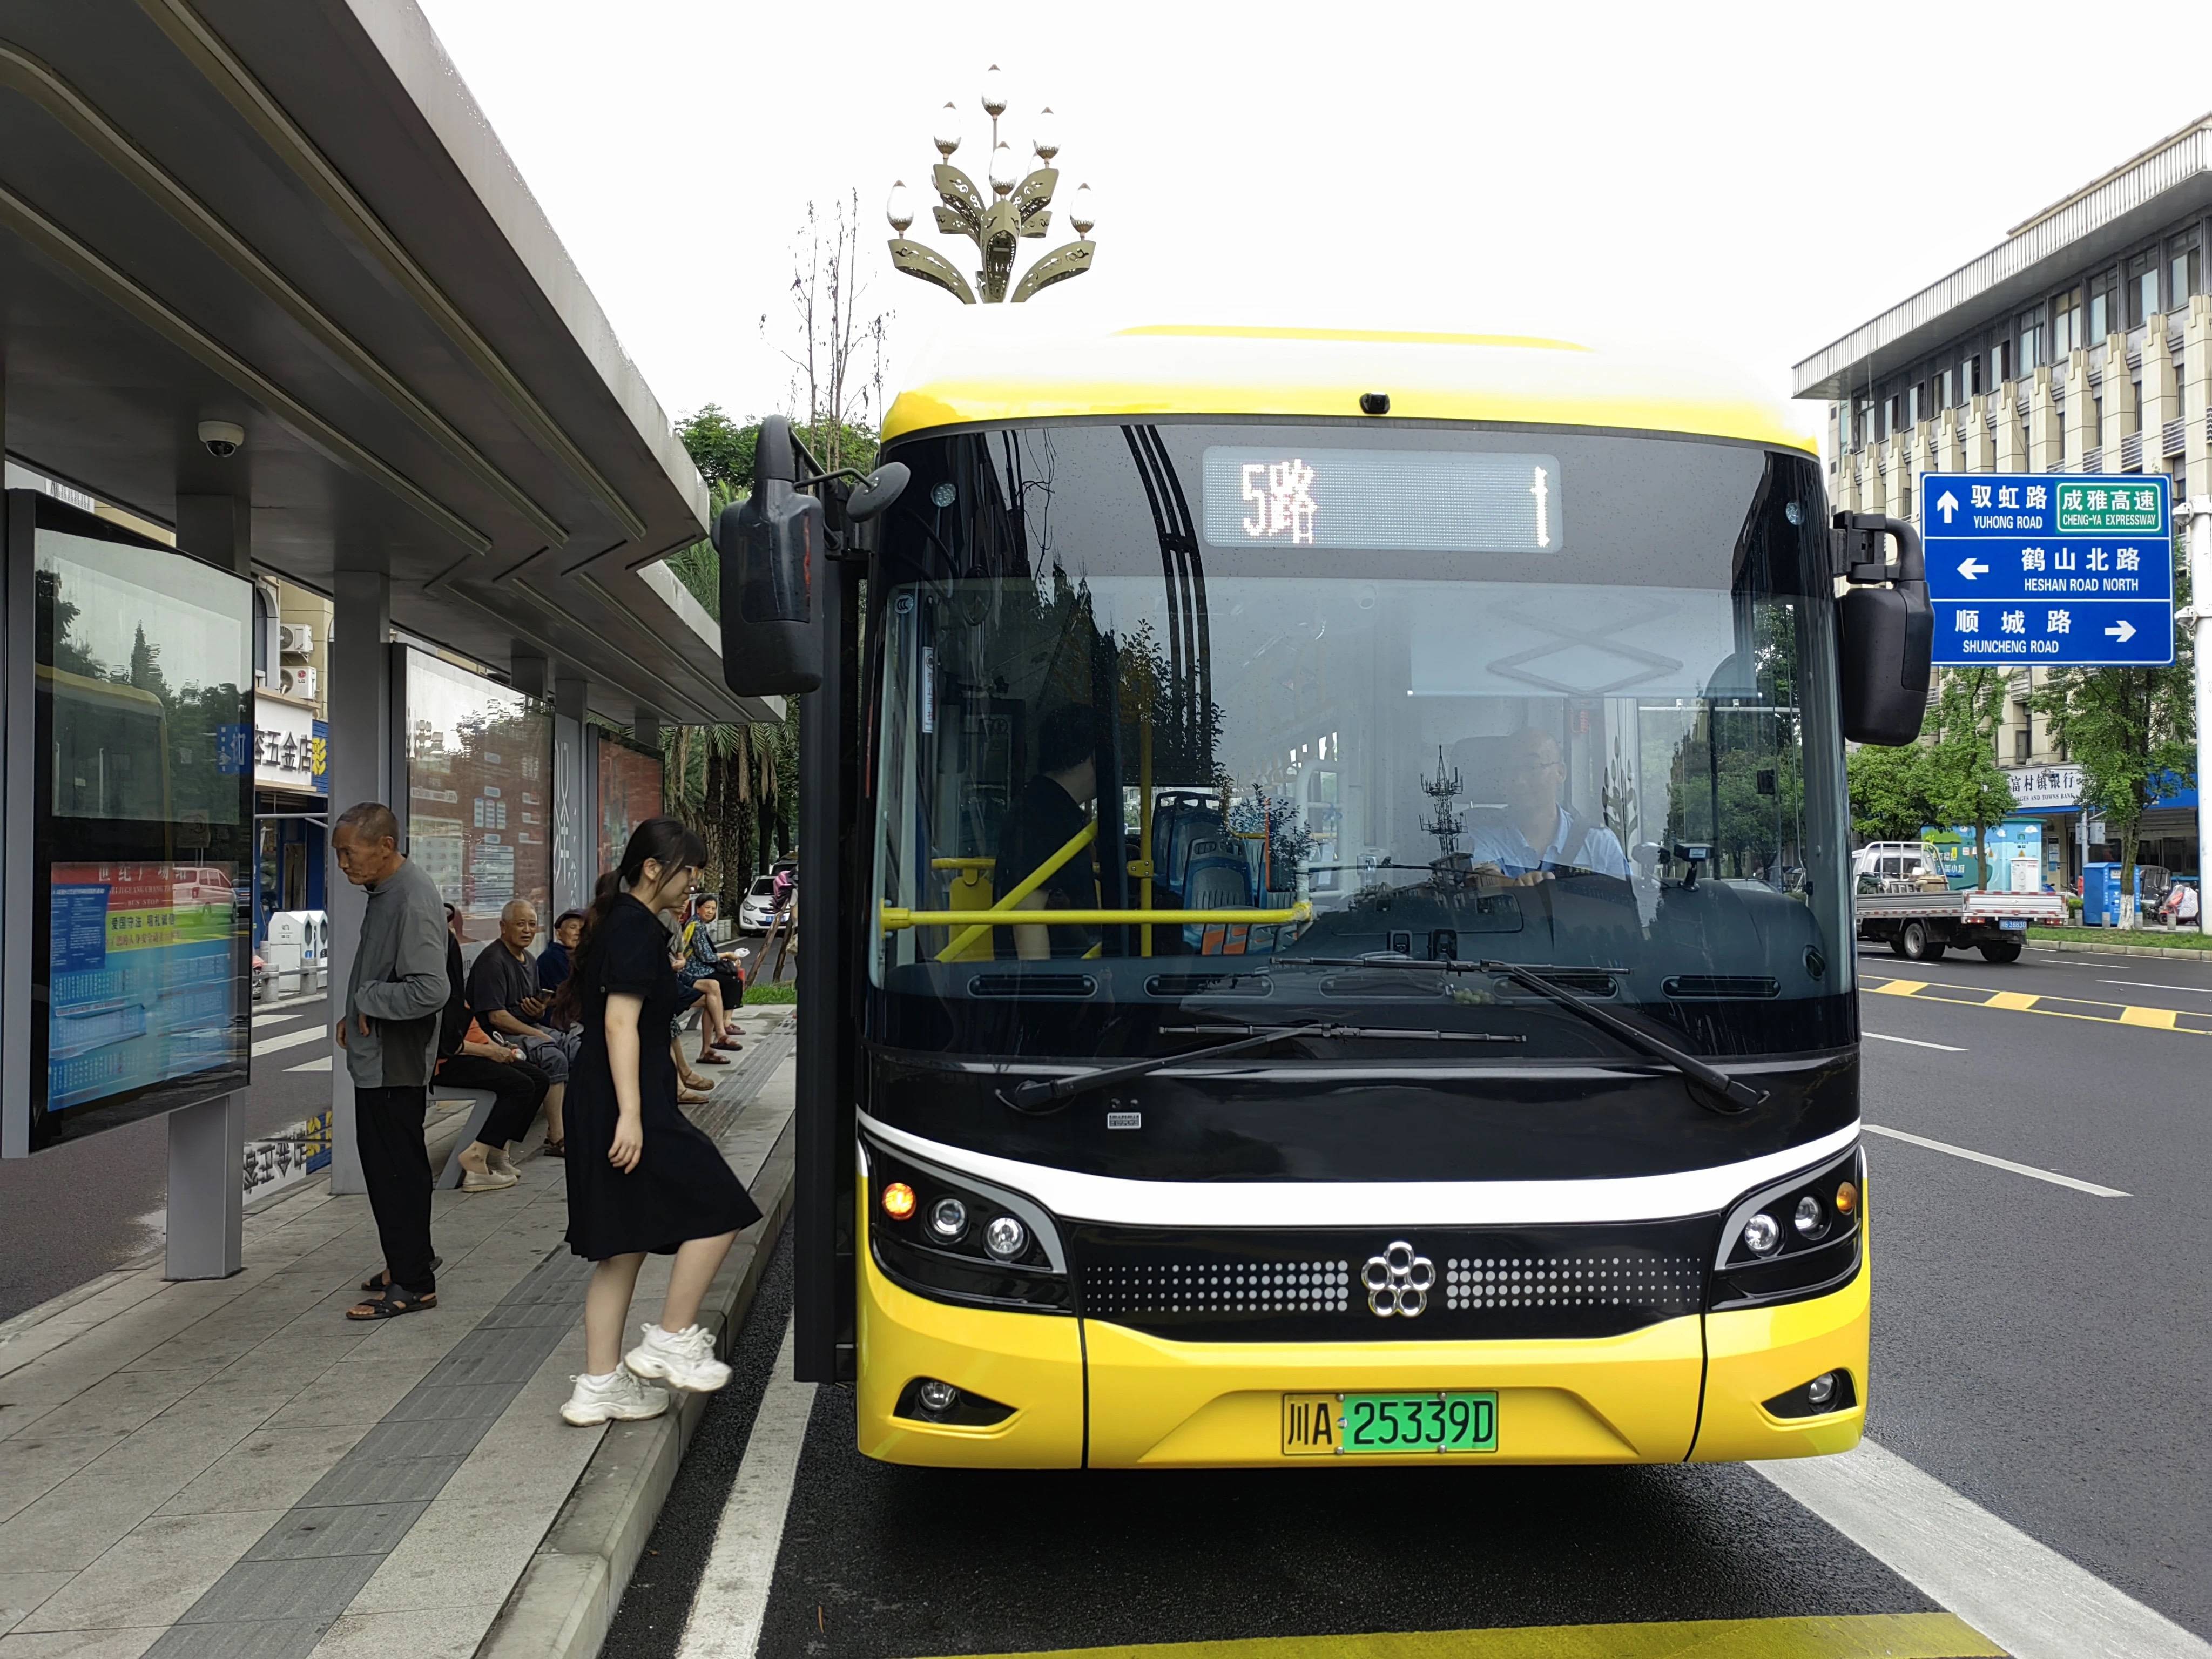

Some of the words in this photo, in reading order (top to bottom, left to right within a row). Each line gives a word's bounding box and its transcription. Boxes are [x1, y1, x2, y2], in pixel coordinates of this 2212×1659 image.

[1970, 484, 2047, 510] 驭虹路
[2062, 489, 2155, 512] 成雅高速
[1973, 515, 2014, 529] YUHONG
[2017, 515, 2043, 529] ROAD
[2062, 514, 2102, 526] CHENG-YA
[2105, 514, 2156, 526] EXPRESSWAY
[2021, 547, 2141, 572] 鹤山北路
[2024, 578, 2067, 592] HESHAN
[2069, 578, 2099, 592] ROAD
[2102, 578, 2139, 591] NORTH
[1954, 609, 2072, 635] 顺城路
[1963, 639, 2027, 654] SHUNCHENG
[2030, 639, 2059, 654] ROAD
[1287, 1400, 1494, 1446] 川A25339D
